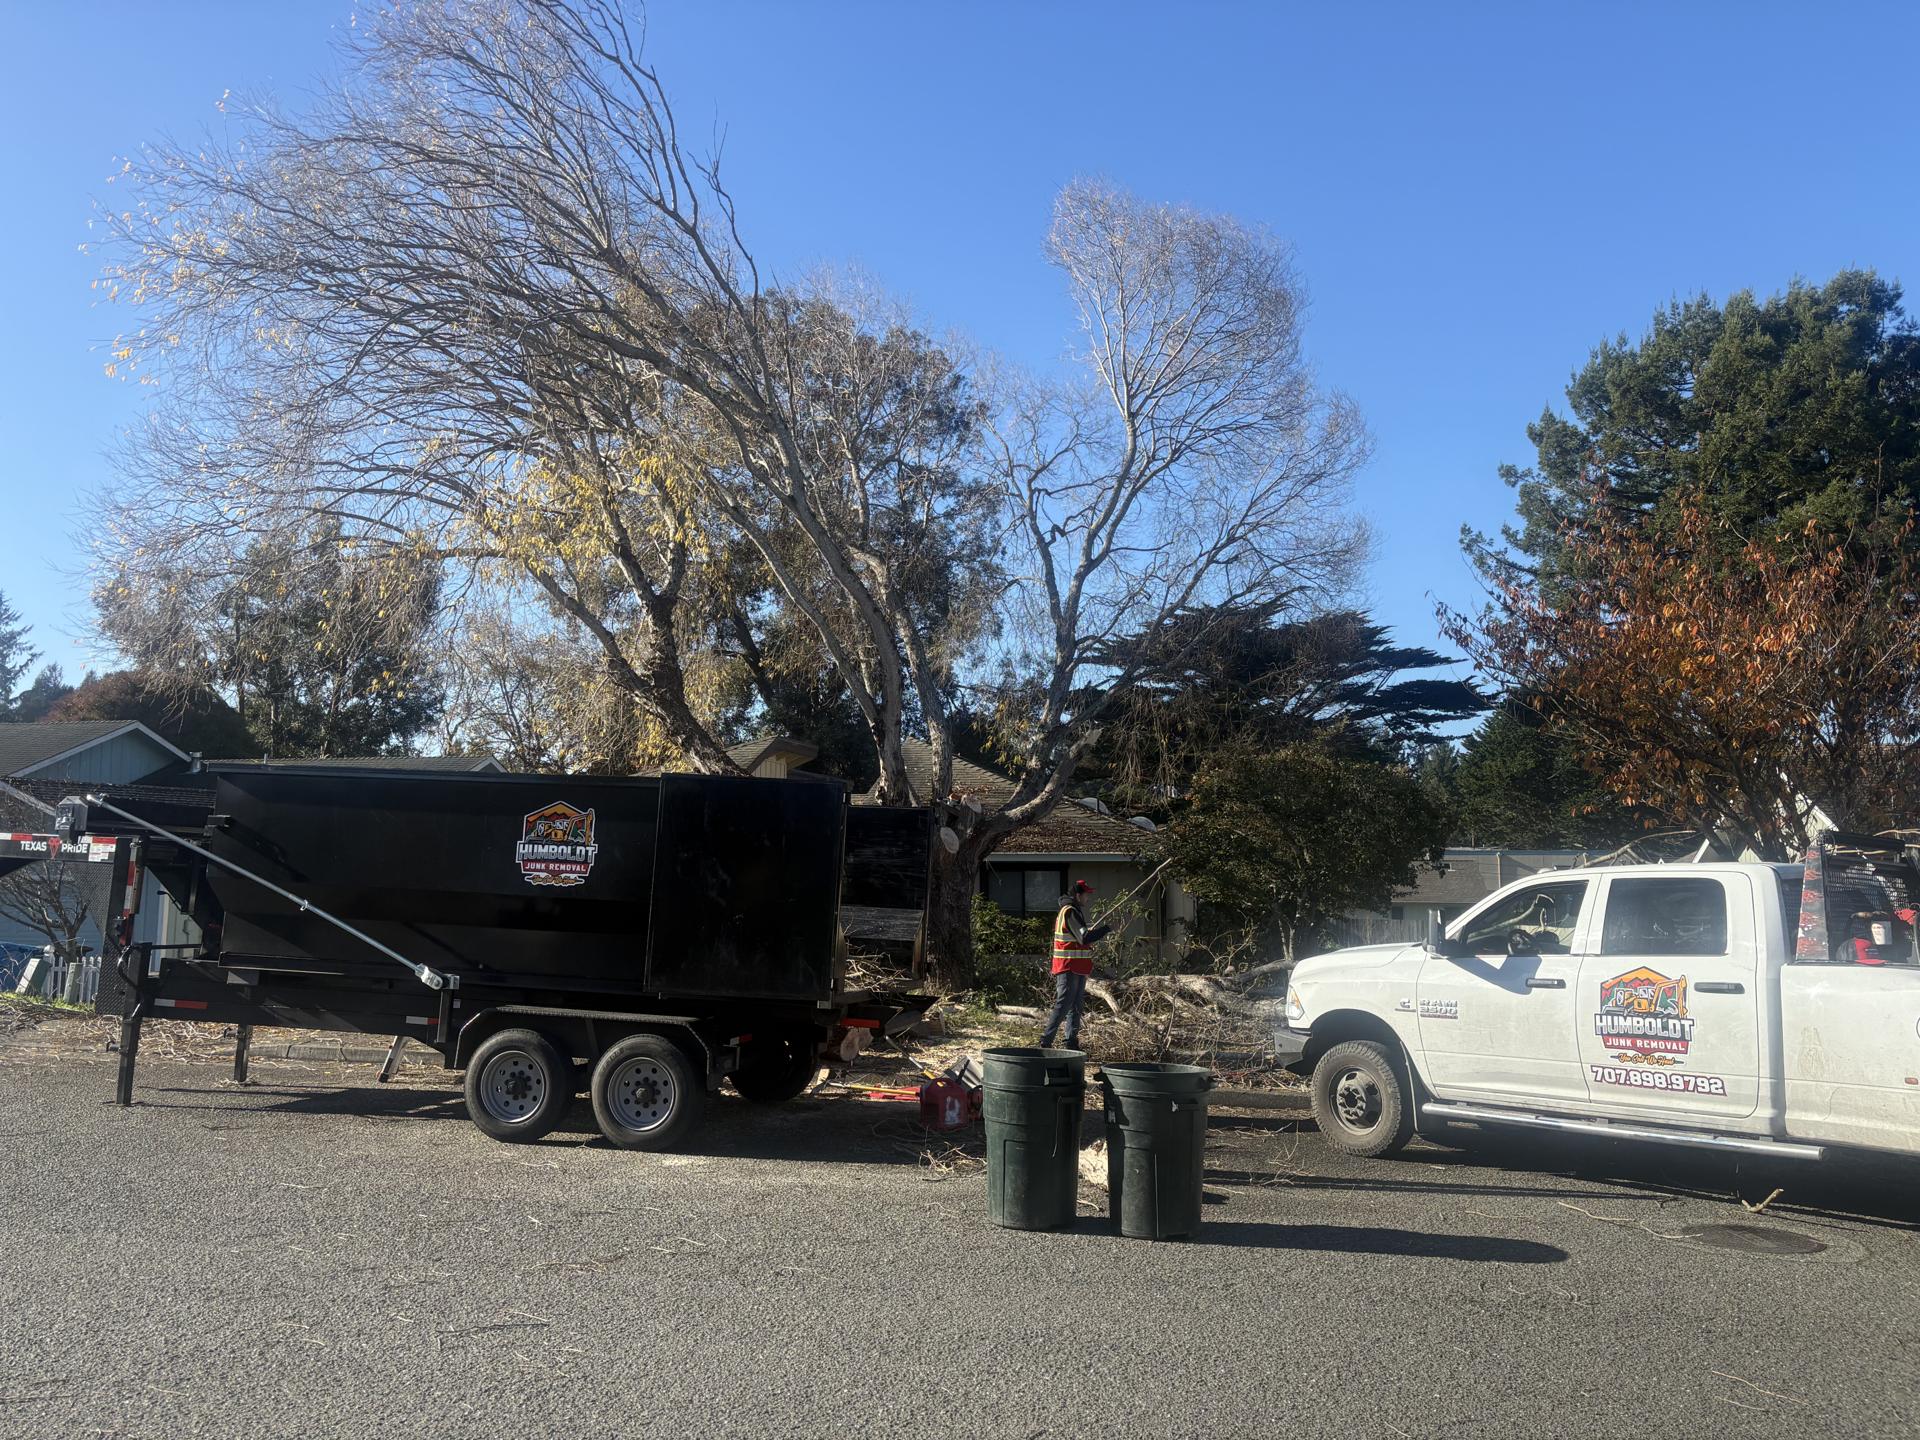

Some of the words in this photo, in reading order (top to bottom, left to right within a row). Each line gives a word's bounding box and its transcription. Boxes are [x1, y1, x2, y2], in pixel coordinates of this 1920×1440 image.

[20, 841, 47, 852] TEXAS
[519, 844, 595, 862] HUMBOLDT
[1420, 1000, 1458, 1008] RAM
[1597, 1015, 1694, 1039] HUMBOLDT
[1606, 1037, 1632, 1047] JUNK
[1637, 1040, 1685, 1050] REMOVAL
[1592, 1067, 1725, 1095] 707.898.9792
